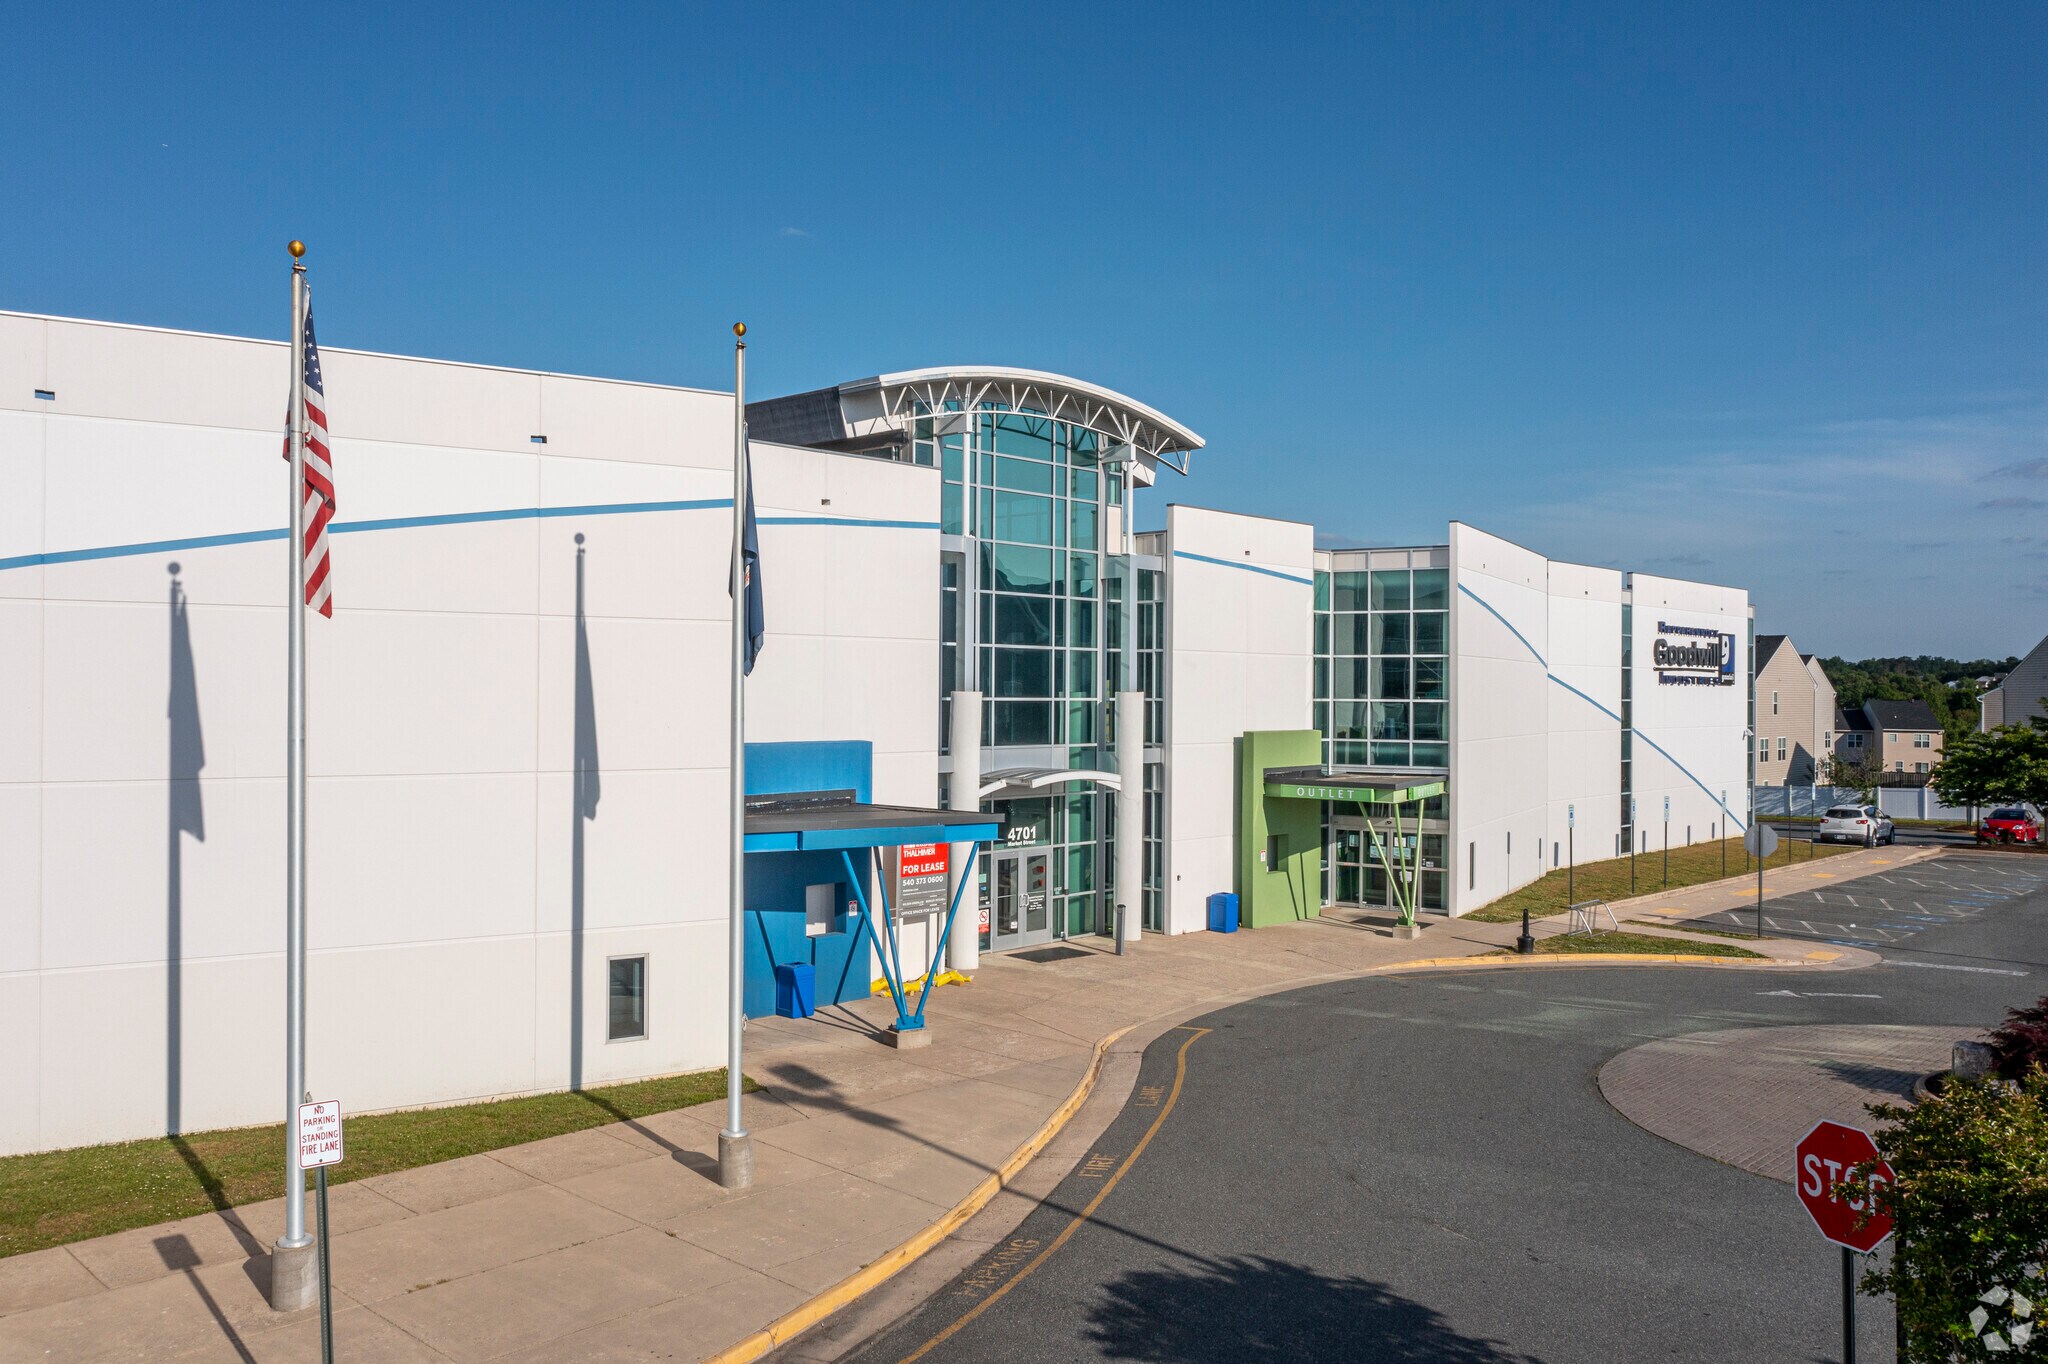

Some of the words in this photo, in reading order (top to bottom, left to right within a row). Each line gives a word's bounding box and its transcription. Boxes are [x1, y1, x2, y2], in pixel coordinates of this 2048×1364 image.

[1654, 639, 1719, 667] Goodwill
[1297, 787, 1354, 799] OUTLET
[1008, 826, 1036, 841] 4701
[903, 848, 935, 858] THALHIMER
[903, 865, 919, 875] FOR
[921, 861, 945, 872] LEASE
[902, 879, 915, 887] 540
[916, 877, 927, 885] 373
[927, 875, 944, 884] 0600
[314, 1106, 324, 1115] NO
[304, 1115, 335, 1127] PARKING
[302, 1130, 338, 1143] STANDING
[302, 1144, 317, 1155] FIRE
[320, 1140, 339, 1152] LANE
